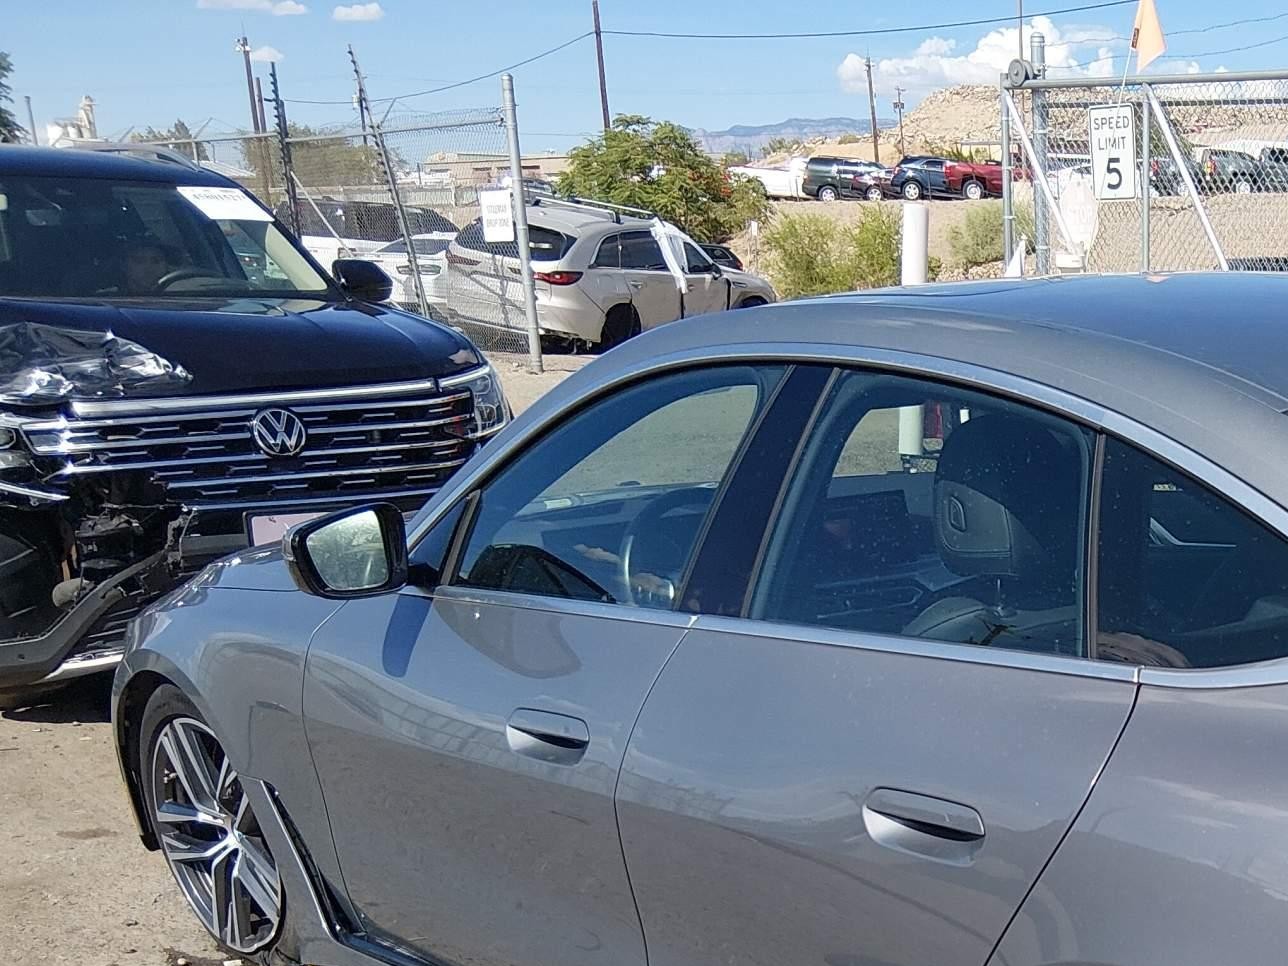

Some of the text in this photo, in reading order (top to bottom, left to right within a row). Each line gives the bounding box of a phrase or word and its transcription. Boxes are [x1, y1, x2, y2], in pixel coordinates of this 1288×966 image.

[1093, 115, 1130, 131] SPEED
[1098, 136, 1127, 150] LIMIT
[1106, 157, 1123, 190] 5
